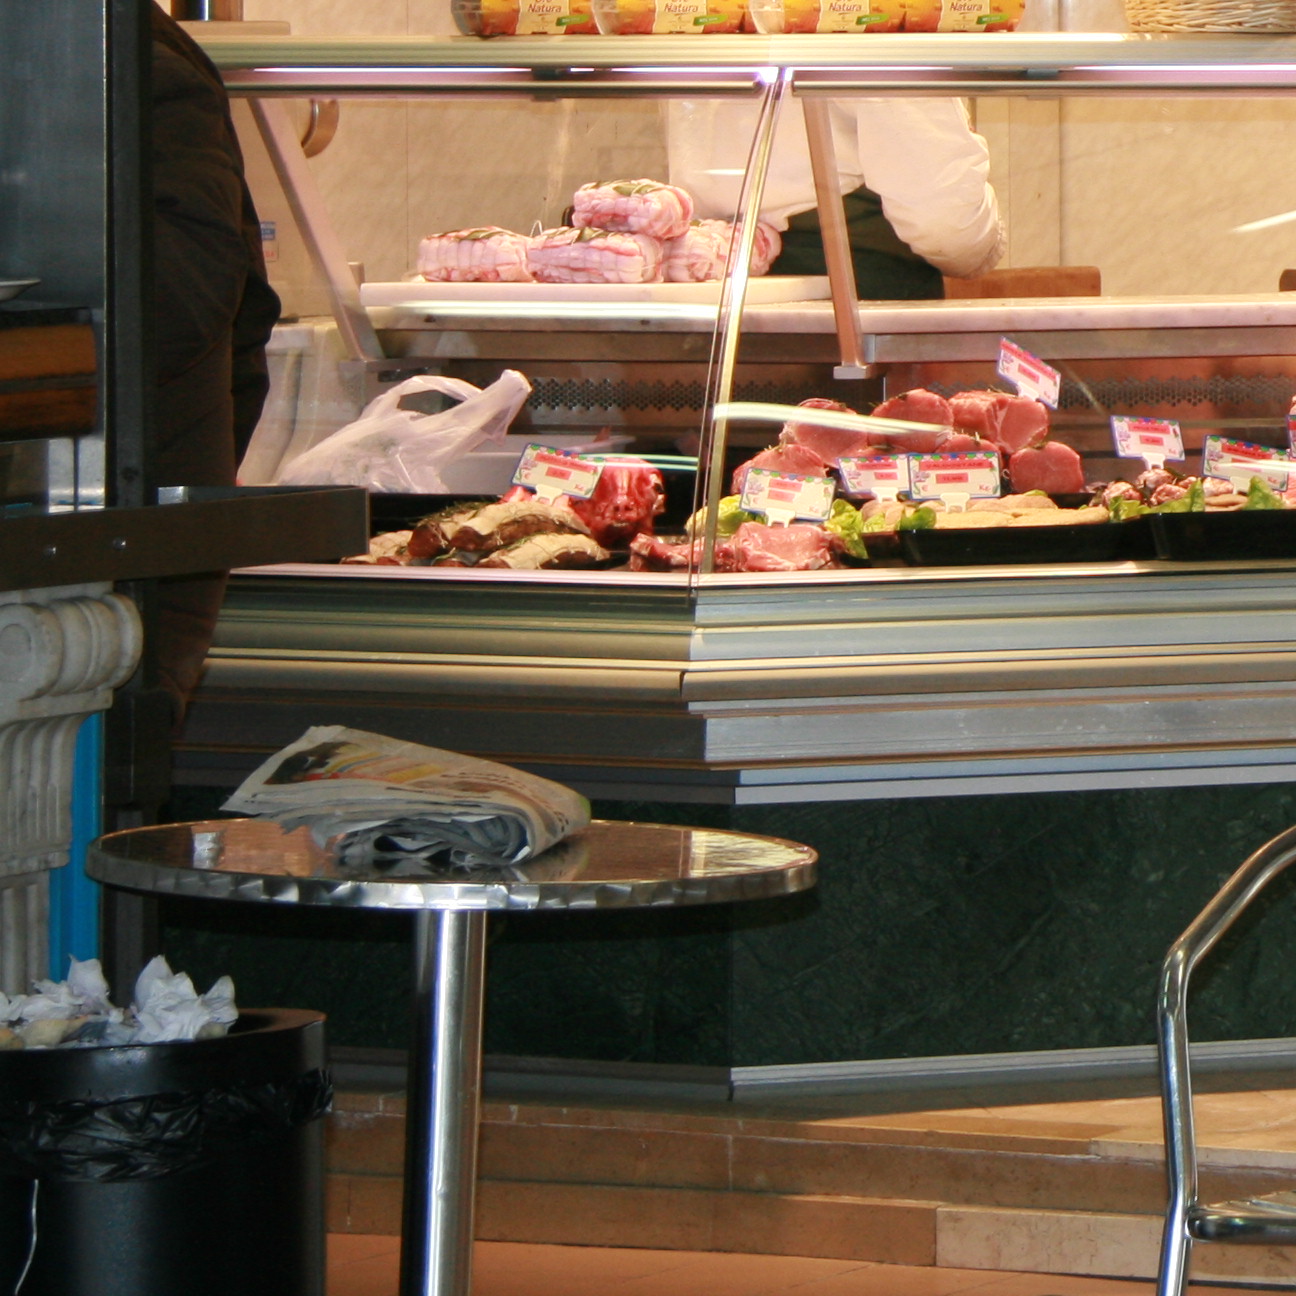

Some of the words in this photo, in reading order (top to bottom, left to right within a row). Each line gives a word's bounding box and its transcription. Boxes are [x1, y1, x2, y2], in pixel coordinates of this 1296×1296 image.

[527, 2, 562, 13] Natura
[664, 2, 699, 13] Natura
[828, 1, 862, 12] Natura
[950, 1, 983, 12] Natura
